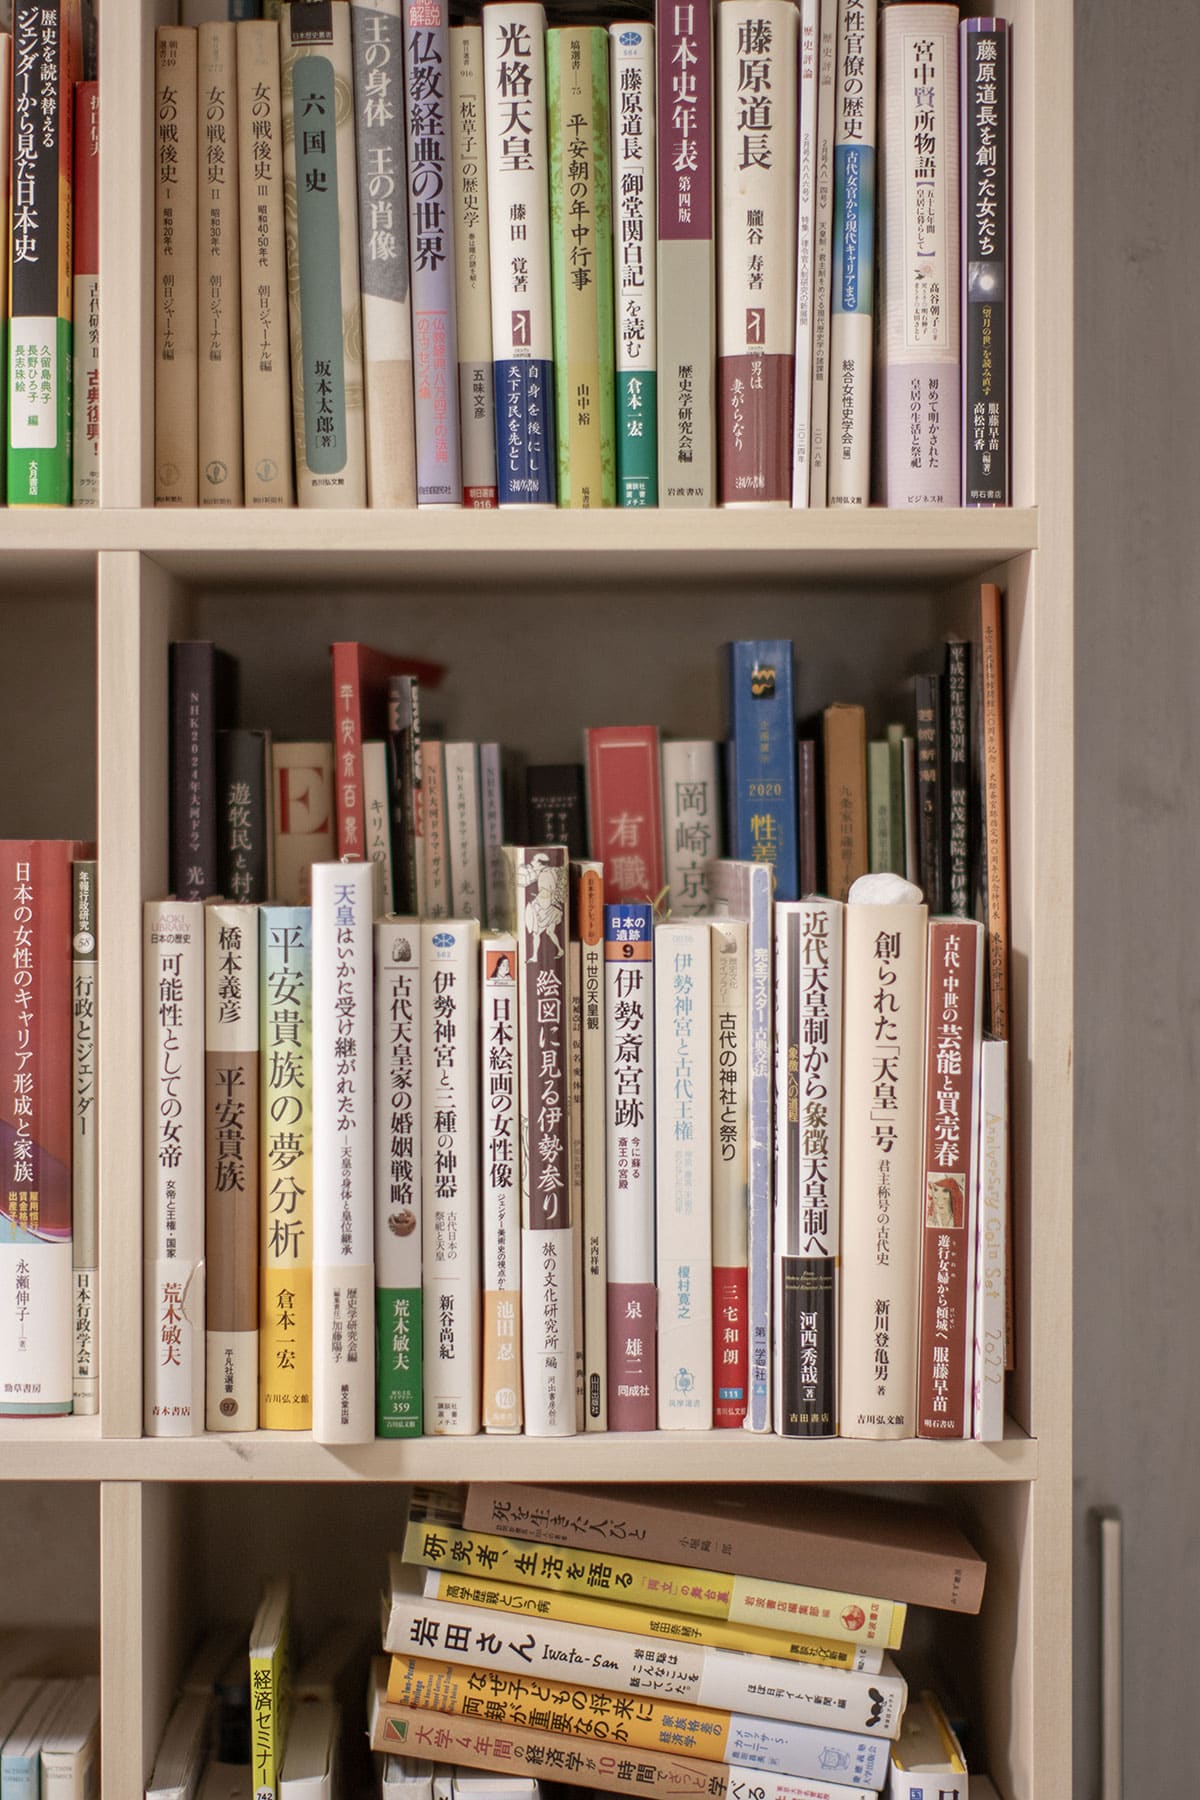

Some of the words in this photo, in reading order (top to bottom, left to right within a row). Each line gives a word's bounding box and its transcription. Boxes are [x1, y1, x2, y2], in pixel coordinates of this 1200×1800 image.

[410, 4, 441, 26] 解説
[41, 9, 57, 148] 歴史を読み替える
[363, 15, 394, 127] 王の身体
[802, 26, 814, 79] 歴史評論
[496, 23, 535, 172] 光格天皇
[671, 4, 698, 172] 日本史年表
[737, 19, 773, 171] 藤原道長
[913, 39, 936, 178] 宮中賢所物語
[14, 6, 39, 263] ジェンダーから見た日本史
[160, 86, 178, 184] 女の戦後史
[206, 86, 225, 184] 女の戦後史
[252, 81, 272, 181] 女の戦後史
[302, 93, 329, 193] 六国史
[408, 31, 446, 272] 仏教経典の世界
[459, 94, 480, 229] 『枕草子』の歴史学
[975, 39, 998, 255] 藤原道長を創った女たち
[163, 208, 173, 256] 昭和20年代
[210, 208, 221, 256] 昭和30年代
[367, 146, 397, 262] 王の肖像
[510, 203, 527, 242] 藤田
[565, 113, 592, 291] 平安朝の年中行事
[619, 67, 645, 358] 藤原道長「御堂関白記」を読む
[678, 175, 691, 224] 第四版
[746, 209, 764, 246] 朧谷
[844, 151, 859, 308] 古代女官から現代キャリアまで
[257, 205, 269, 267] 昭和40・50年代
[511, 256, 528, 293] 覚著
[748, 254, 764, 290] 寿著
[162, 274, 175, 361] 朝日ジャーナル編
[209, 274, 222, 361] 朝日ジャーナル編
[258, 285, 273, 372] 朝日ジャーナル編
[28, 345, 38, 402] 長野ひろ子
[41, 345, 51, 404] 久留島典子
[473, 369, 485, 419] 五味文彦
[577, 383, 591, 426] 山中裕
[627, 377, 642, 437] 倉本一宏
[751, 360, 764, 390] 男は
[28, 415, 38, 426] 編
[507, 365, 522, 471] 天下万民を先とし
[528, 365, 541, 471] 自身を後にし
[678, 364, 693, 463] 歴史学研究会編
[910, 377, 922, 468] 皇居の生活と祭祀
[928, 377, 940, 468] 初めて明かされた
[973, 402, 985, 450] 高松百香
[988, 402, 1000, 450] 服藤早苗
[667, 487, 704, 496] 岩波書店
[907, 495, 944, 503] ビジネス社
[970, 490, 1001, 499] 明石書店
[340, 684, 358, 844] 平安京百景
[749, 783, 782, 795] 2020
[279, 767, 329, 834] E
[228, 783, 253, 904] 遊牧民と村
[609, 812, 648, 891] 有職
[79, 871, 89, 931] 年報行政研究
[611, 917, 645, 928] 日本の
[151, 934, 191, 944] 日本の歴史
[616, 930, 640, 941] 遺跡
[622, 944, 633, 958] 9
[218, 925, 242, 1024] 橋本義彦
[334, 883, 357, 1132] 天皇はいかに受け継がれたか
[586, 951, 599, 1030] 中世の天皇観
[754, 948, 769, 1022] 完全マスター
[13, 862, 35, 1183] 日本の女性のキャリア形成と家族
[74, 975, 95, 1136] 行政とジェンダー
[614, 968, 644, 1128] 伊勢斎宮跡
[673, 953, 694, 1141] 伊勢神宮と古代王権
[754, 1028, 769, 1077] 古典文法
[870, 931, 901, 1152] 創られた「天皇」号
[934, 934, 962, 1167] 古代・中世の芸能と買売春
[159, 953, 184, 1168] 可能性としての女帝
[268, 925, 306, 1259] 平安貴族の夢分析
[390, 974, 413, 1205] 古代天皇家の婚姻戦略
[433, 970, 457, 1198] 伊勢神宮と三種の神器
[489, 999, 514, 1188] 日本絵画の女性像
[719, 1012, 737, 1161] 古代の神社と祭り
[802, 911, 829, 1256] 近代天皇制から象徴天皇制へ
[537, 969, 564, 1220] 絵図に見る伊勢参り
[215, 1066, 245, 1192] 平安貴族
[631, 1137, 640, 1178] 今に蘇る
[618, 1137, 628, 1190] 斎王の宮殿
[166, 1179, 176, 1258] 女帝と王権・国家
[435, 1211, 445, 1261] 祭祀と天皇
[446, 1211, 457, 1260] 古代日本の
[876, 1160, 890, 1266] 君主称号の古代史
[15, 1259, 30, 1322] 永瀬伸子
[76, 1273, 92, 1364] 日本行政学会
[497, 1301, 514, 1337] 池田
[541, 1242, 559, 1350] 旅の文化研究所
[625, 1300, 642, 1319] 泉
[935, 1234, 950, 1339] 遊行女婦から傾城へ
[161, 1282, 182, 1366] 荒木敏夫
[276, 1287, 296, 1370] 倉本一宏
[392, 1299, 410, 1370] 荒木敏夫
[439, 1294, 455, 1359] 新谷尚紀
[722, 1284, 739, 1365] 三宅和朗
[800, 1311, 818, 1384] 河西秀哉
[874, 1298, 890, 1381] 新川登亀男
[984, 1329, 1001, 1385] 2022
[4, 1383, 41, 1393] 勁草書房
[224, 1349, 234, 1393] 平凡社選書
[544, 1357, 558, 1369] 編
[618, 1385, 650, 1396] 同成社
[932, 1346, 949, 1412] 服藤早苗
[151, 1406, 191, 1416] 青木書店
[264, 1393, 309, 1404] 吉川弘文館
[392, 1402, 410, 1413] 359
[547, 1376, 556, 1425] 河出書房新社
[790, 1413, 829, 1423] 吉田書店
[856, 1414, 905, 1425] 吉川弘文館
[923, 1419, 955, 1428] 明石書店
[493, 1500, 646, 1540] 死を生きた人びと
[423, 1533, 633, 1589] 研究者、生活を語る
[446, 1585, 551, 1613] 高学歴親という病
[410, 1617, 537, 1663] 岩田さん
[542, 1644, 619, 1670] Iwata-San
[633, 1665, 699, 1682] こんなことを
[462, 1695, 629, 1743] 両親が重要なのか
[467, 1672, 653, 1722] なぜ子どもの将来に
[629, 1677, 692, 1694] 話していた。
[254, 1669, 273, 1785] 経済セミナー
[659, 1731, 697, 1748] 経済学
[734, 1740, 769, 1752] カーニー
